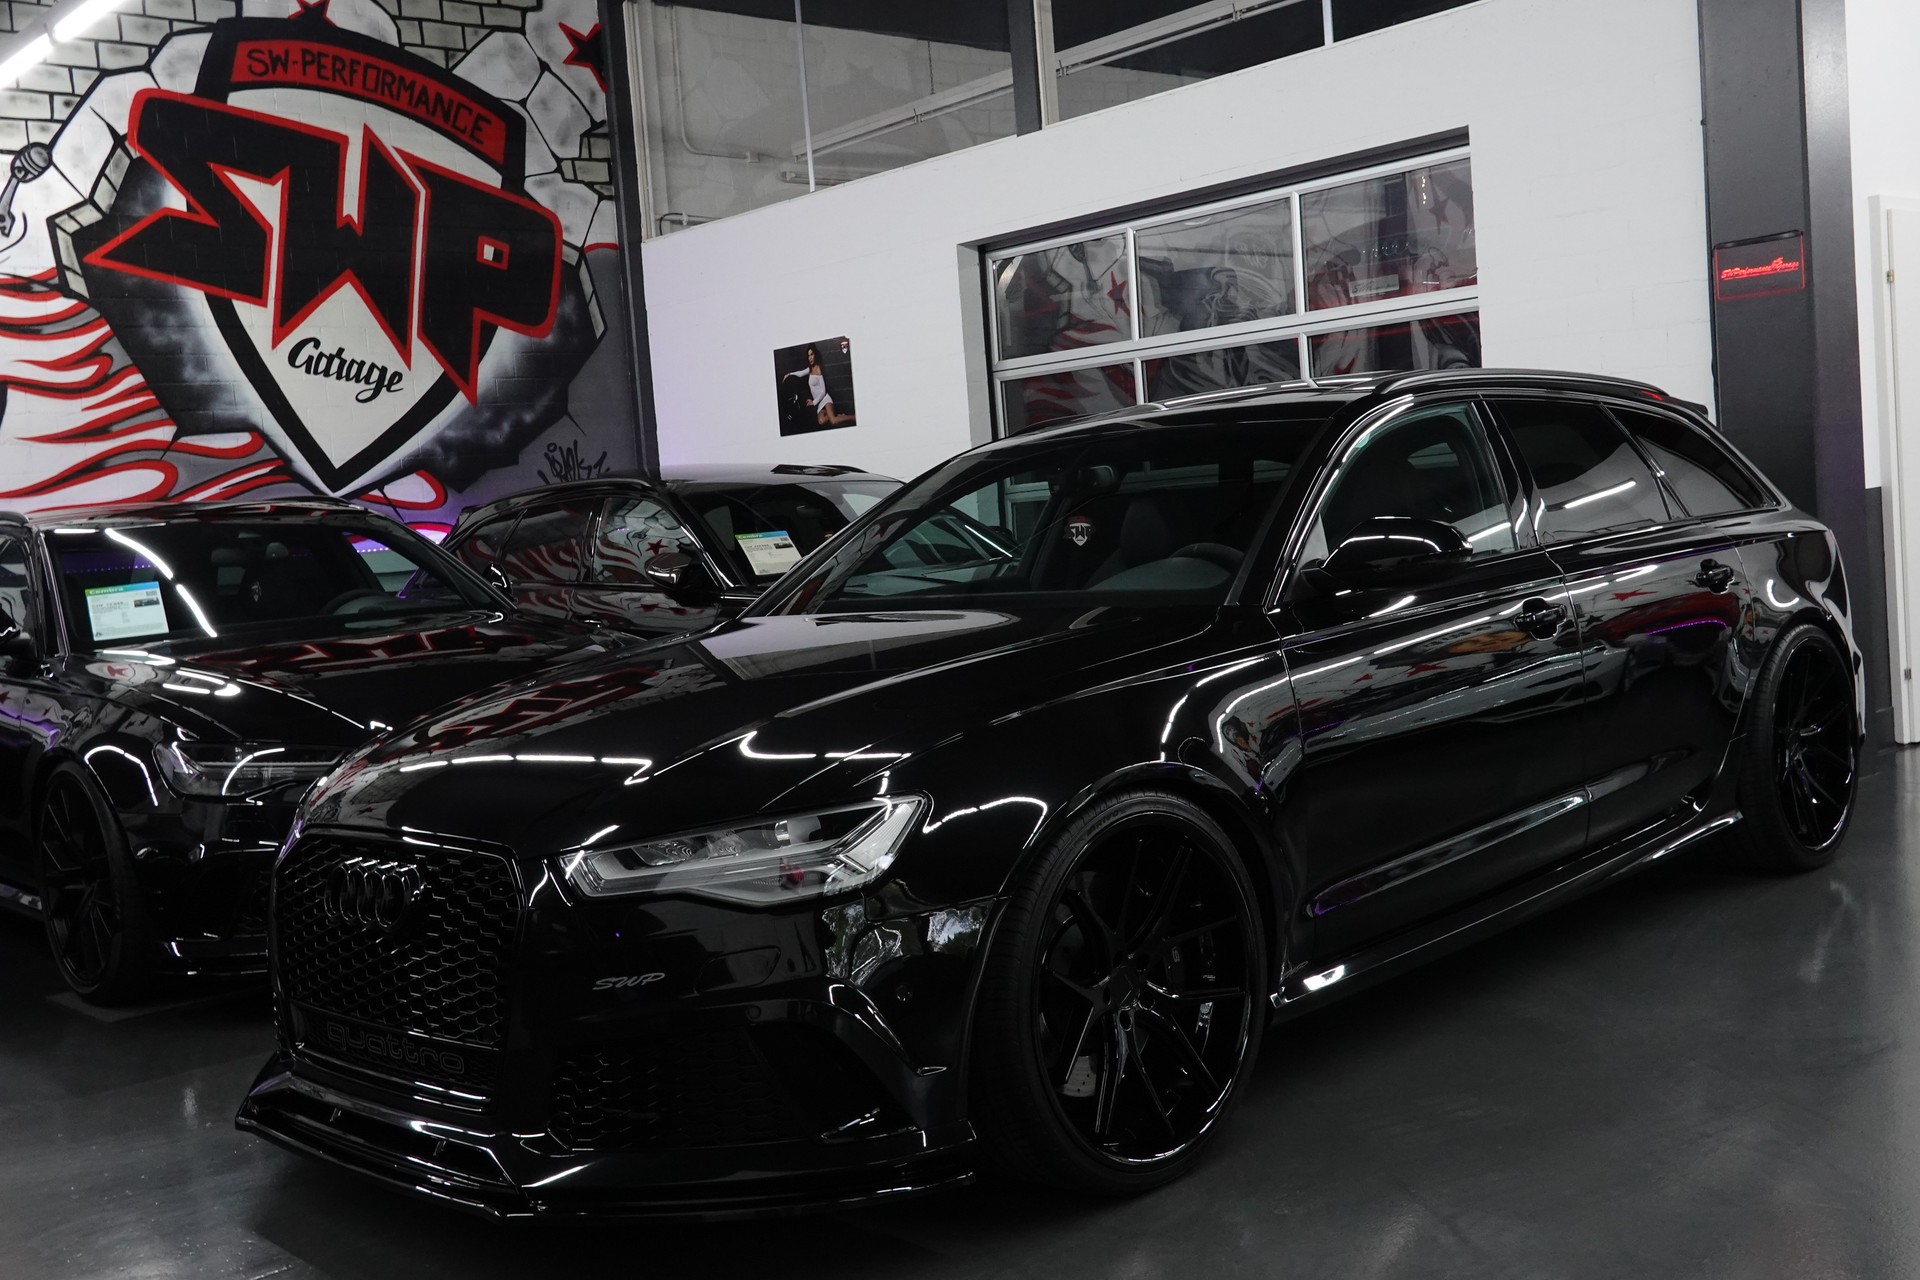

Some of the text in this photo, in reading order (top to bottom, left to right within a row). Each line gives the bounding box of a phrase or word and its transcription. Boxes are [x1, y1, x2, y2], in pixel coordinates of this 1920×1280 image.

[247, 49, 492, 145] SW-PERFORMANCE
[83, 88, 563, 407] SWP
[288, 337, 404, 403] Garage
[592, 972, 666, 990] SWP
[327, 1022, 465, 1075] quattro
